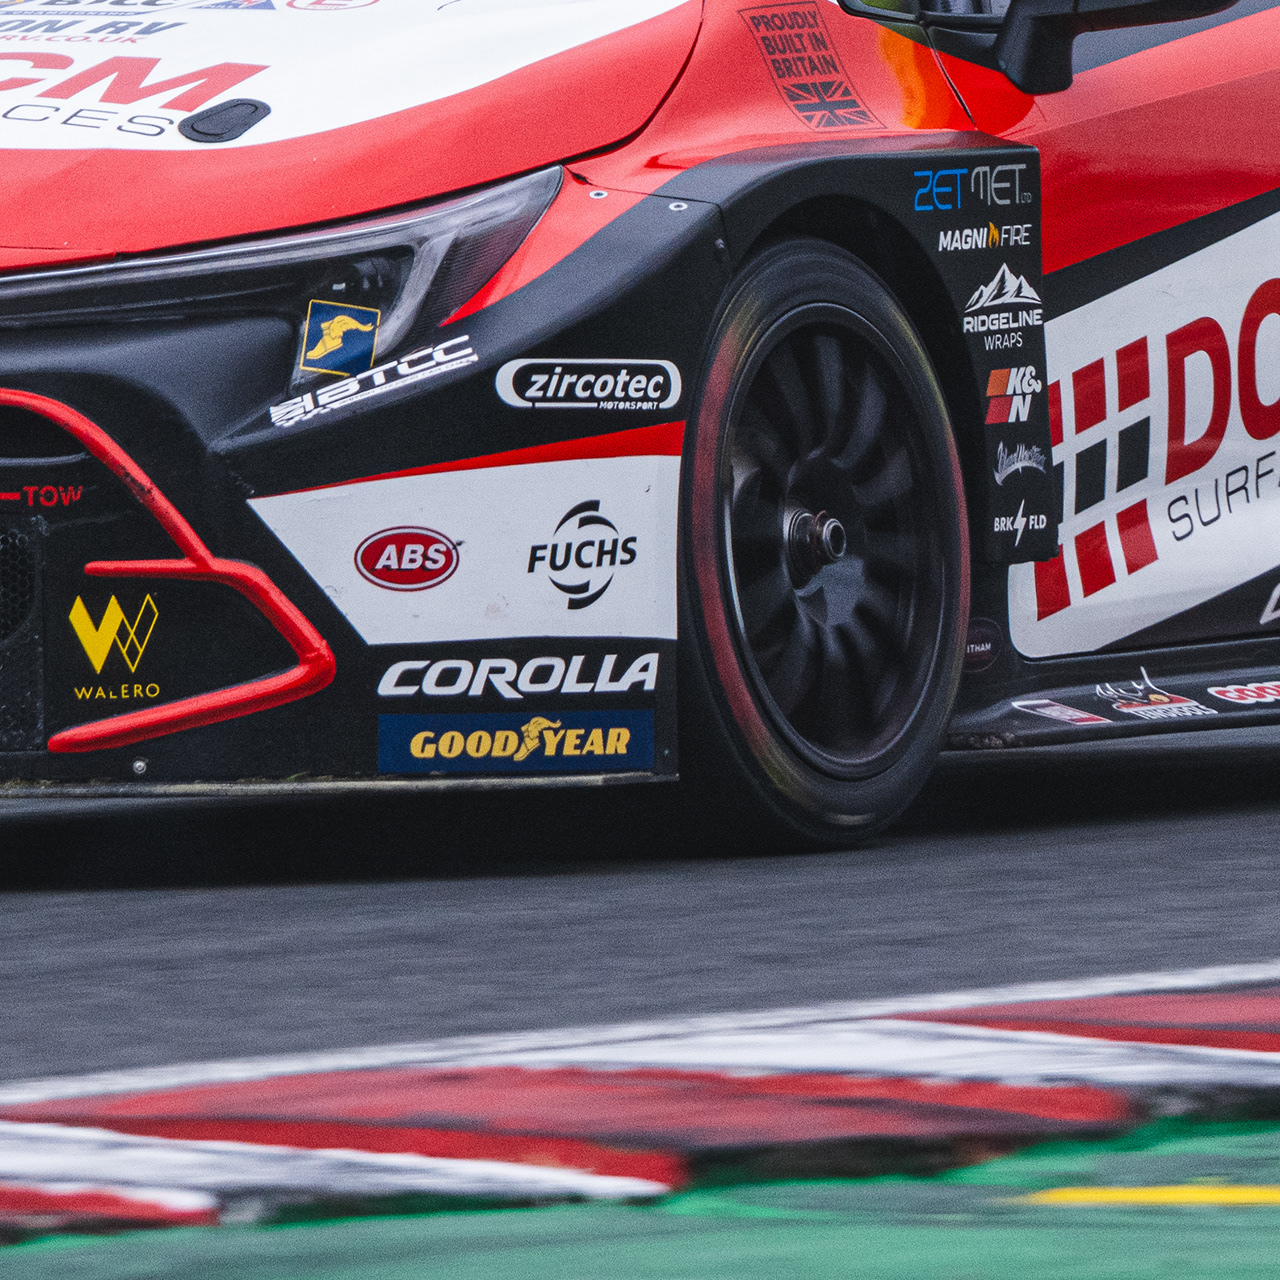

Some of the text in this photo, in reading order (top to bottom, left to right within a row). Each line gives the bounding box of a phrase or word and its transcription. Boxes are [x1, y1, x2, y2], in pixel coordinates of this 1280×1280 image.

[86, 20, 188, 36] RV
[749, 10, 819, 32] PROUDLY
[761, 32, 829, 55] BUILT IN
[771, 54, 840, 78] BRITAIN
[963, 309, 1043, 333] RIDGELINE
[984, 332, 1023, 351] WRAPS
[316, 335, 473, 406] BTCC
[525, 367, 664, 398] zircotec
[599, 401, 658, 410] MOTORSPORT
[23, 485, 84, 507] TOW
[375, 543, 447, 570] ABS
[527, 536, 638, 573] FUCHS
[967, 642, 992, 654] ITHAM
[377, 653, 660, 699] COROLLA
[74, 683, 160, 699] WALERO
